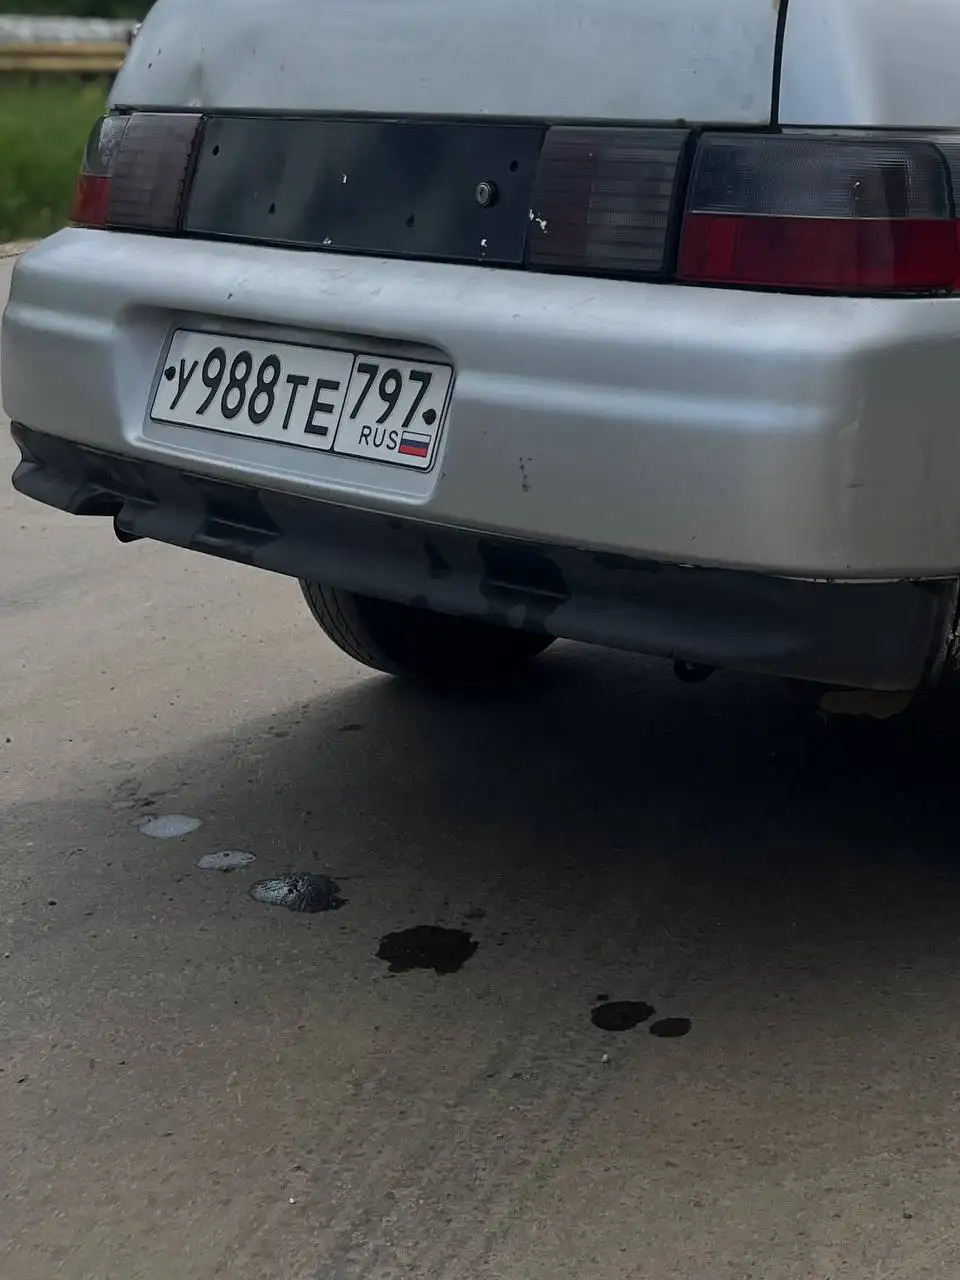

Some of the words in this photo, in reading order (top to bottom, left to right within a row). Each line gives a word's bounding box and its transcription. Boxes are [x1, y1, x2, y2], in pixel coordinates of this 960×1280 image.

[169, 346, 341, 437] У988ТЕ
[349, 363, 433, 428] 797
[358, 425, 399, 451] RUS
